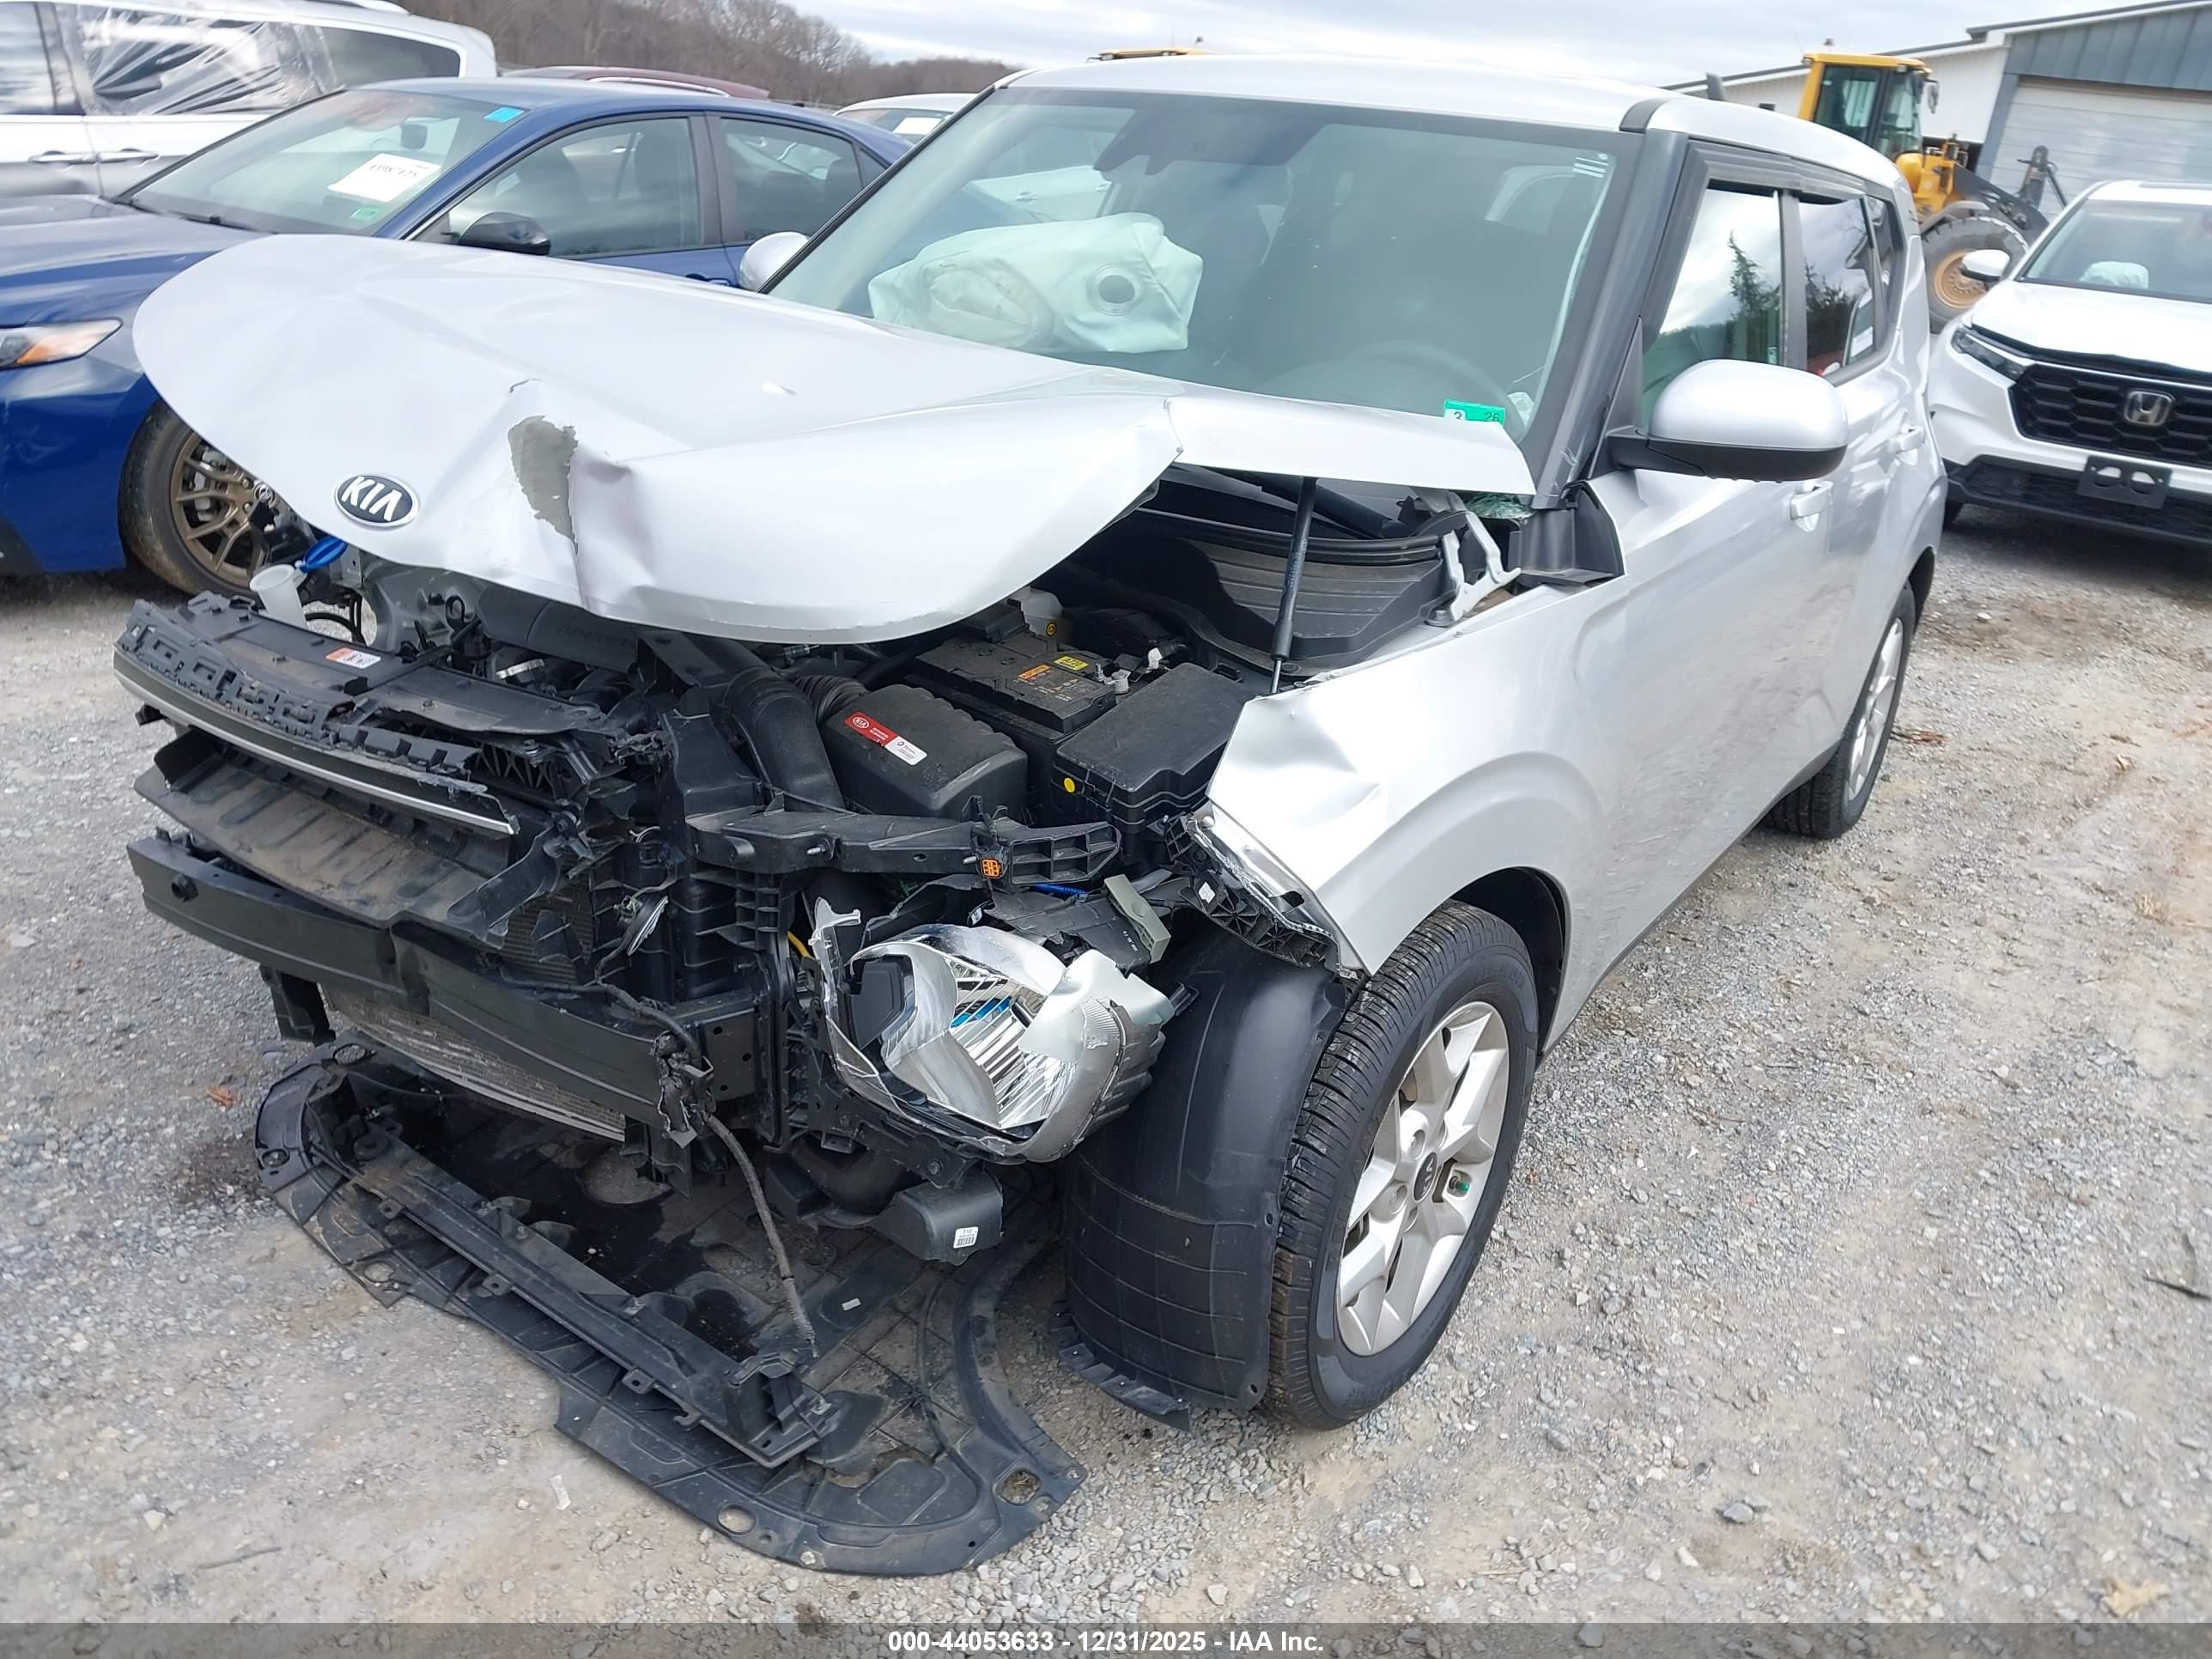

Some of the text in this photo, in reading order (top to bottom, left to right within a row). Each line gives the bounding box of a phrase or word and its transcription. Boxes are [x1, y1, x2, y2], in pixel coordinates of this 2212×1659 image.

[1484, 411, 1500, 422] 26
[341, 476, 403, 522] KIA
[855, 719, 867, 728] KIA
